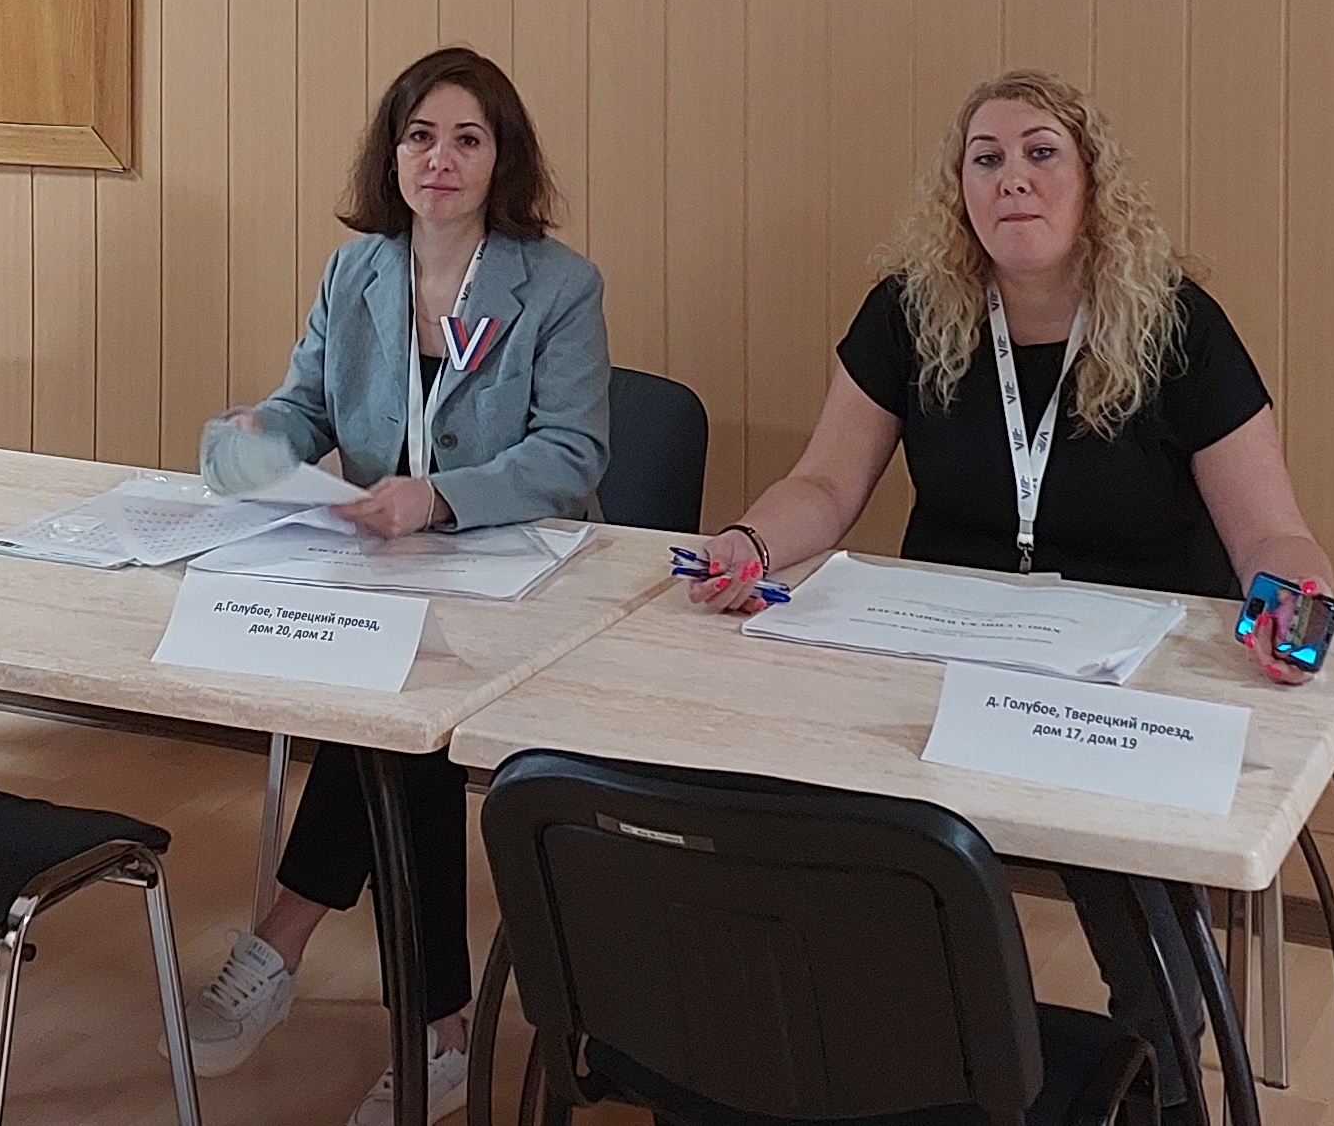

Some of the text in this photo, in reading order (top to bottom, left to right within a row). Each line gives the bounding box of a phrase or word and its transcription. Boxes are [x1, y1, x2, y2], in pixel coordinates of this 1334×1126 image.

[276, 607, 335, 624] Тверецкий
[337, 616, 380, 631] проезд,
[248, 623, 334, 641] дом 20, дом 21
[986, 695, 1194, 741] д. Голубое, Тверецкий проезд,
[1032, 723, 1138, 750] дом 17, дом 19
